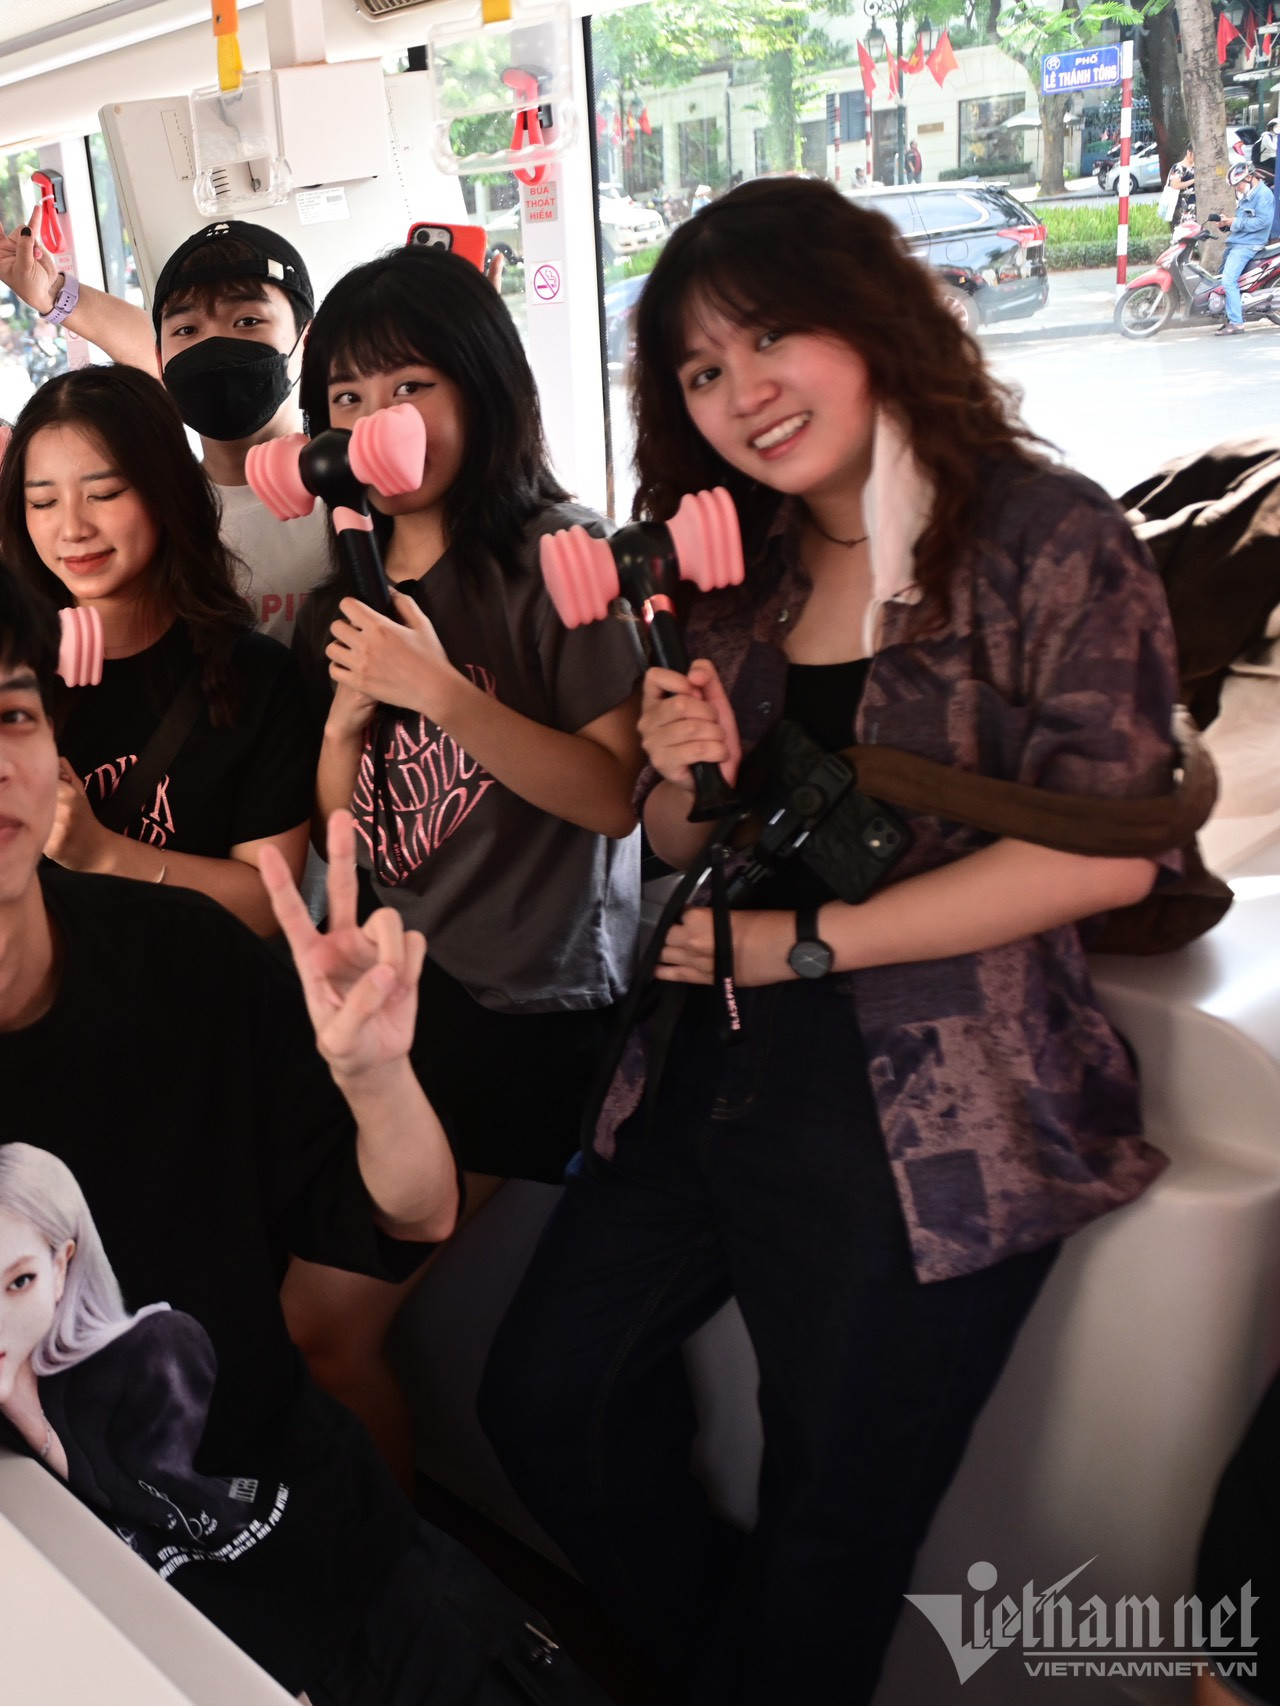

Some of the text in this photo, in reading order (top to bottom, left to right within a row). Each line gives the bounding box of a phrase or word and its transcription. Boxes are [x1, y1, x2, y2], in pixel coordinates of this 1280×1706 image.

[1075, 52, 1098, 66] PHỐ
[1045, 64, 1117, 88] LÊ THÁNH TÔNG
[526, 197, 555, 208] THOÁT
[529, 207, 553, 220] HIỂM
